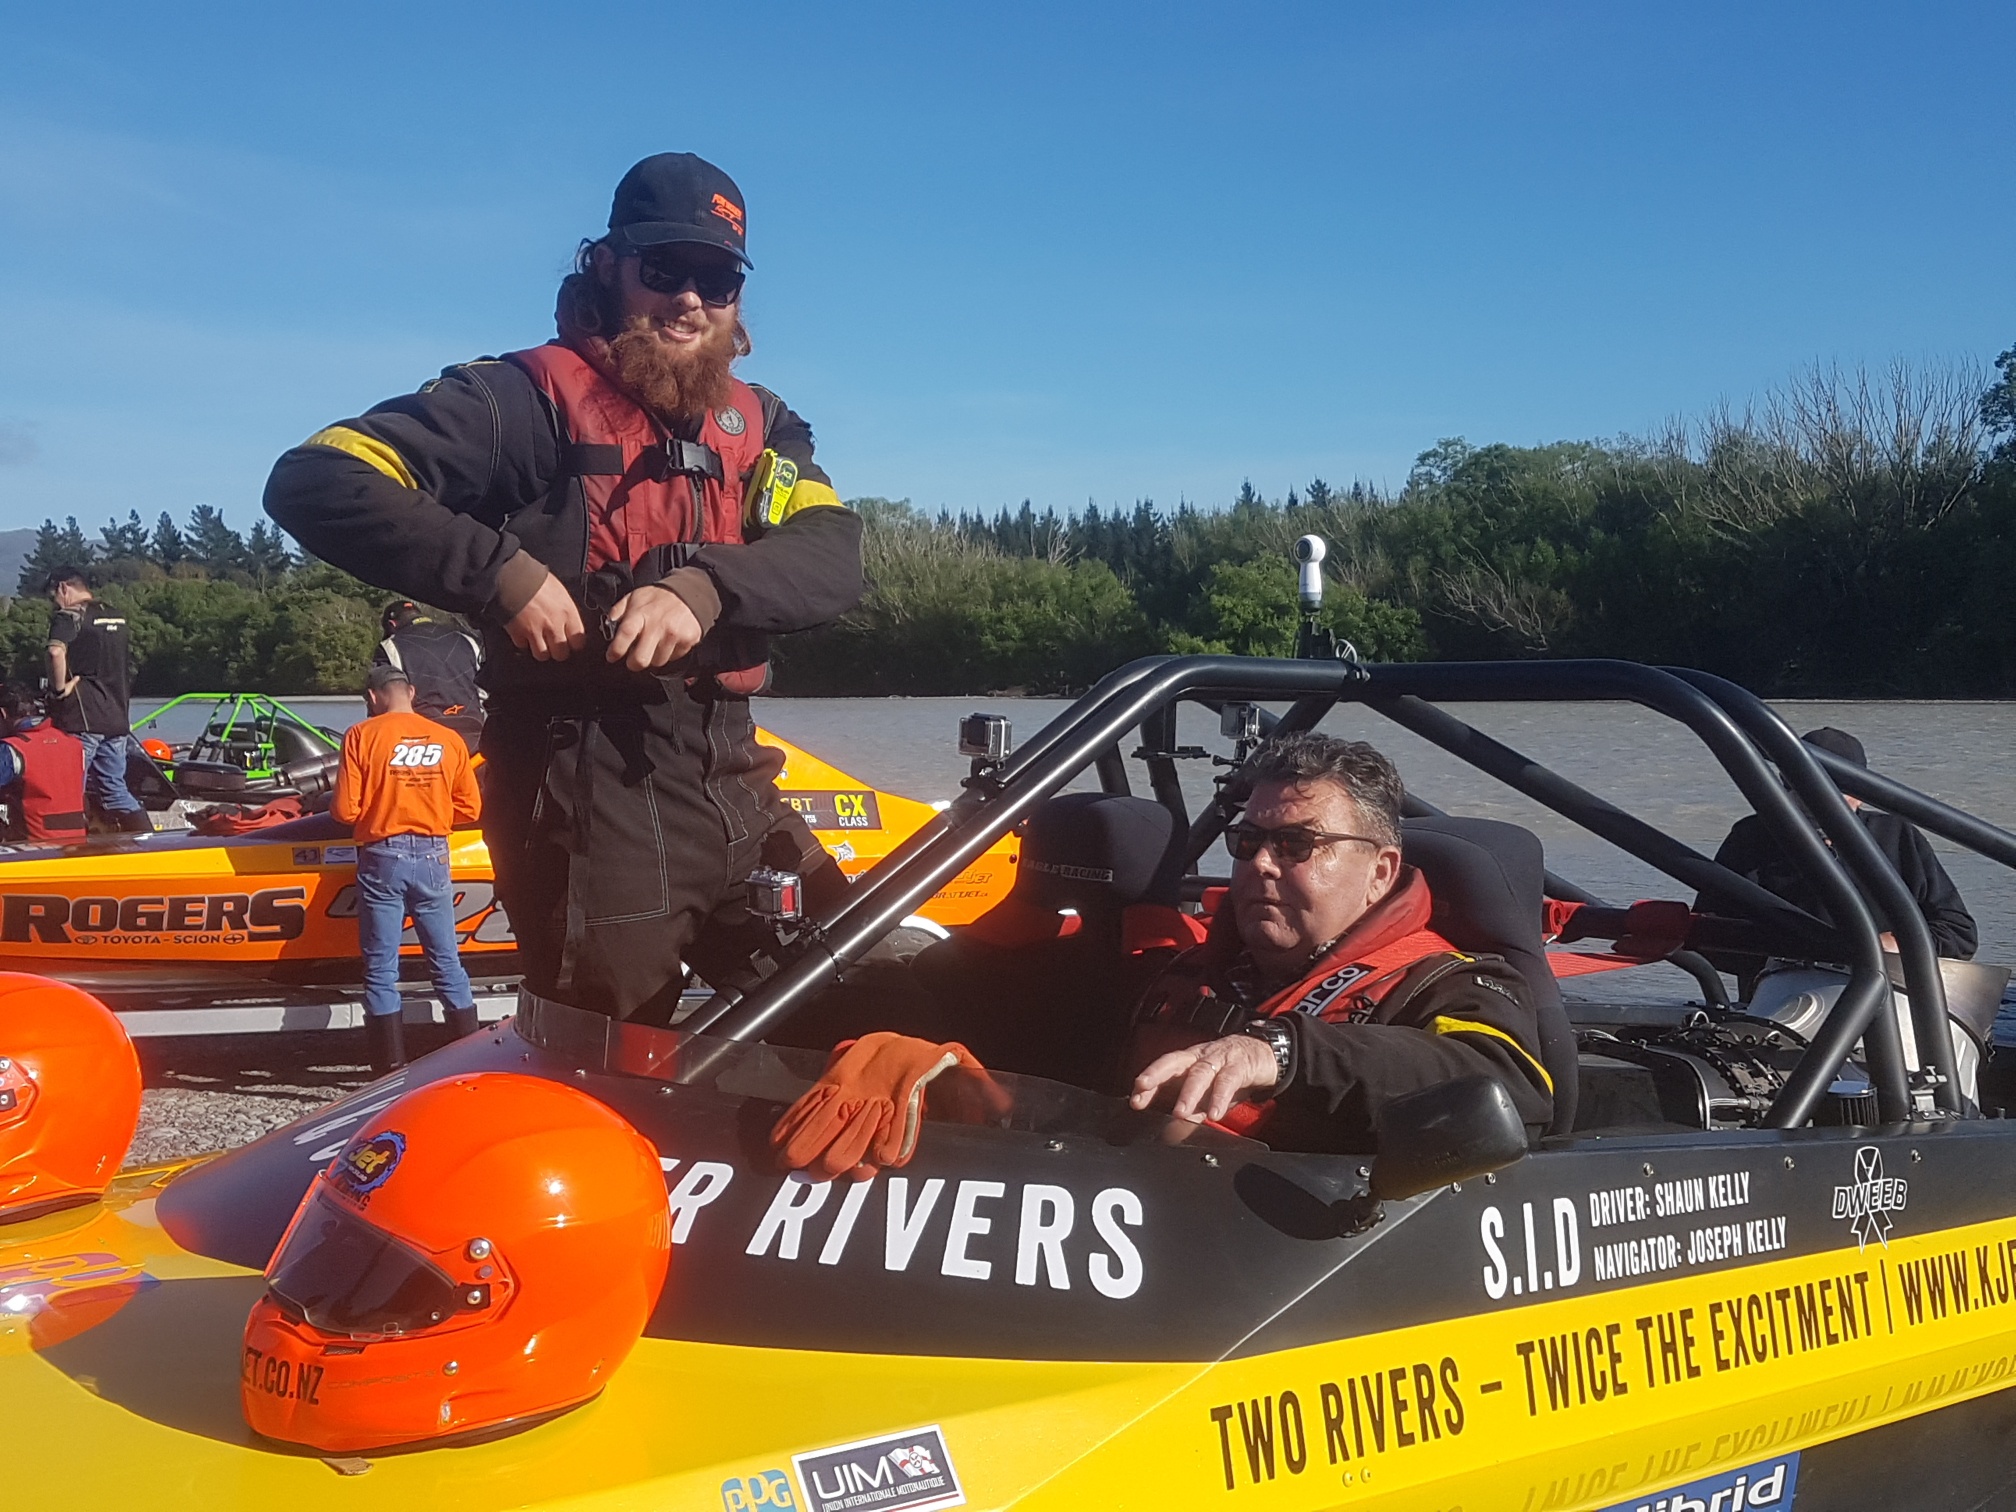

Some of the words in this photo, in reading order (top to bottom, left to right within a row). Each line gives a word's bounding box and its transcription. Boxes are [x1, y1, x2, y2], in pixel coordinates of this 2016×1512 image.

[389, 743, 444, 767] 285
[834, 794, 867, 817] CX
[838, 816, 868, 827] CLASS
[1, 888, 306, 943] ROGERS
[102, 934, 161, 945] TOYOTA
[173, 934, 221, 945] SCION
[1589, 1186, 1651, 1227] DRIVER:
[1655, 1178, 1706, 1218] SHAUN
[1709, 1171, 1751, 1210] KELLY
[1832, 1178, 1908, 1219] DWEEB
[745, 1171, 1143, 1299] RIVERS
[1480, 1197, 1581, 1300] S.I.D
[1594, 1235, 1682, 1282] NAVIGATOR:
[1687, 1225, 1743, 1266] JOSEPH
[1746, 1216, 1787, 1255] KELLY
[1210, 1390, 1307, 1491] TWO
[1320, 1357, 1464, 1466] RIVERS
[1516, 1323, 1628, 1417] TWICE
[1636, 1308, 1701, 1388] THE
[1710, 1271, 1872, 1372] EXCITMENT
[812, 1455, 894, 1500] UIM
[822, 1501, 844, 1512] UNION
[844, 1487, 896, 1509] INTERNATIONALE
[897, 1475, 946, 1496] MOTONAUTIQUE
